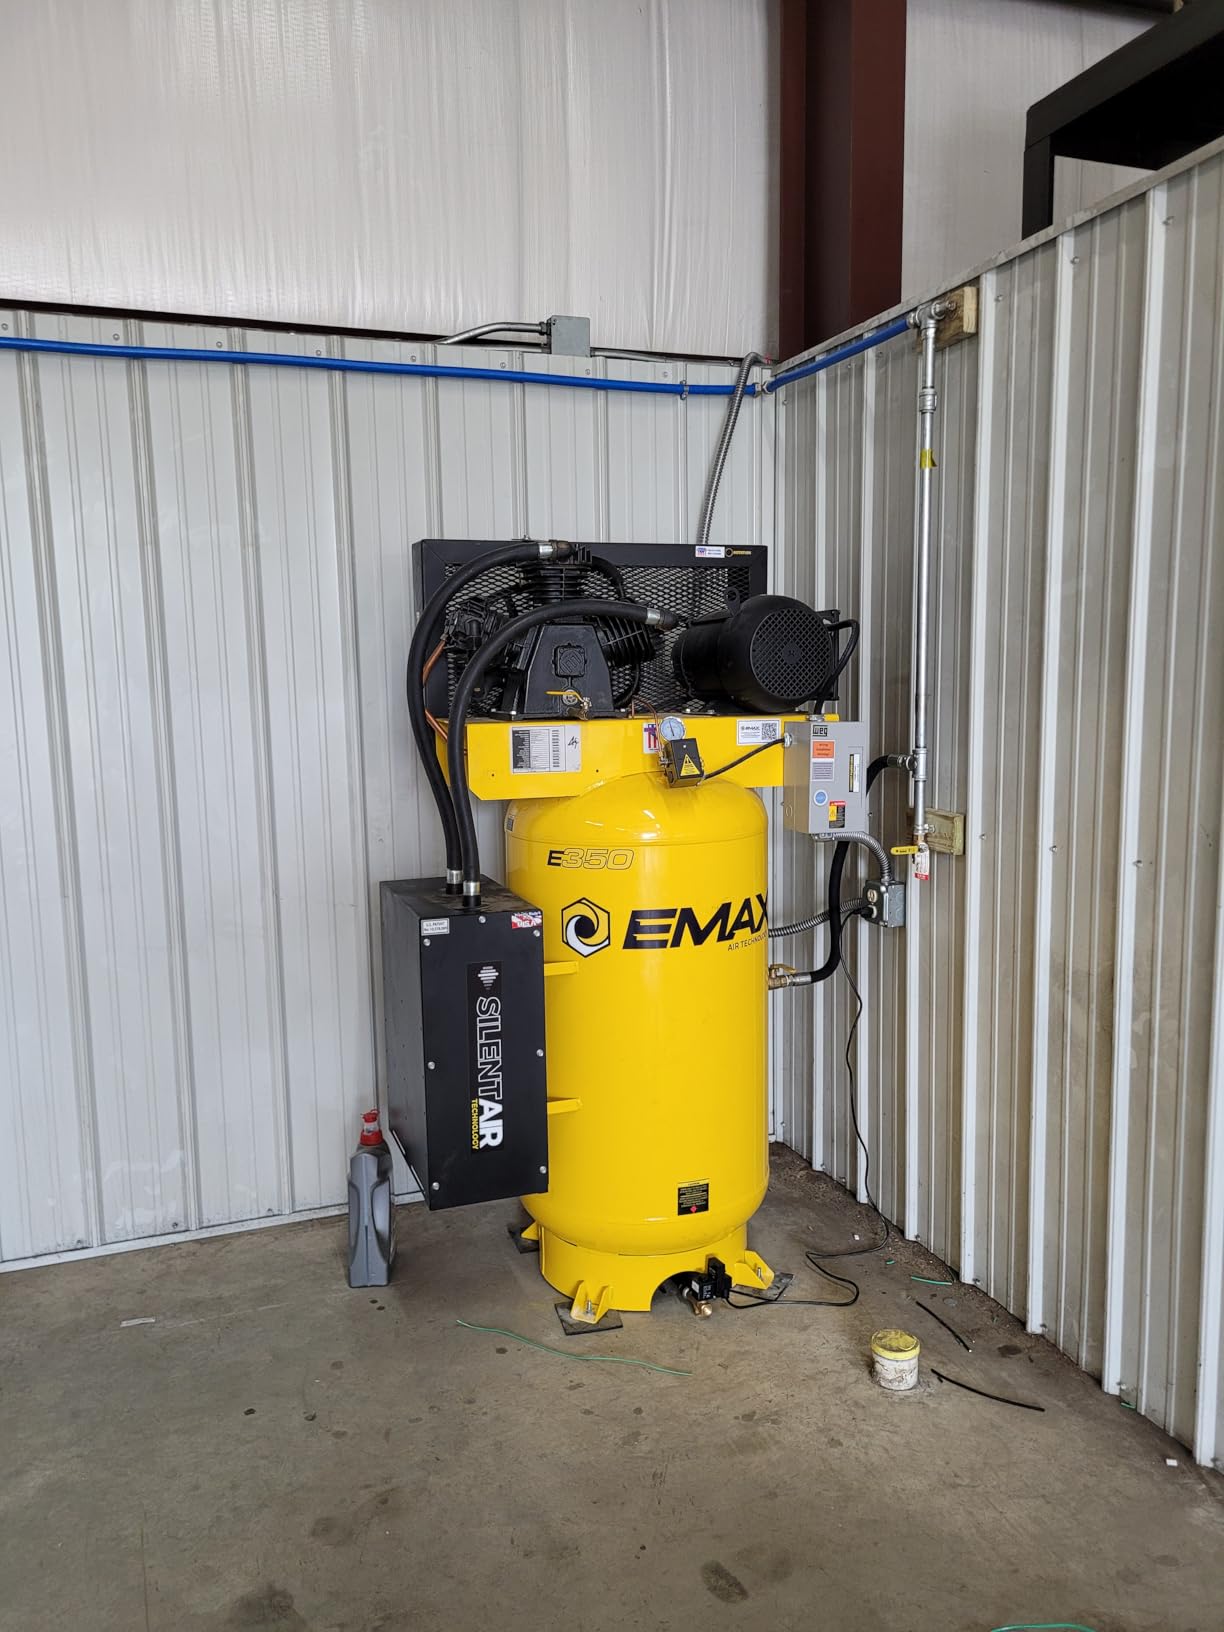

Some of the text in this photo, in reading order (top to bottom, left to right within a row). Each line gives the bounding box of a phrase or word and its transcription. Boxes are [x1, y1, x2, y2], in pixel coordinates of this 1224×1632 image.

[547, 848, 635, 870] E350
[622, 888, 768, 950] EMAX
[728, 941, 740, 951] AIR
[471, 1098, 479, 1150] TECHNOLOGY
